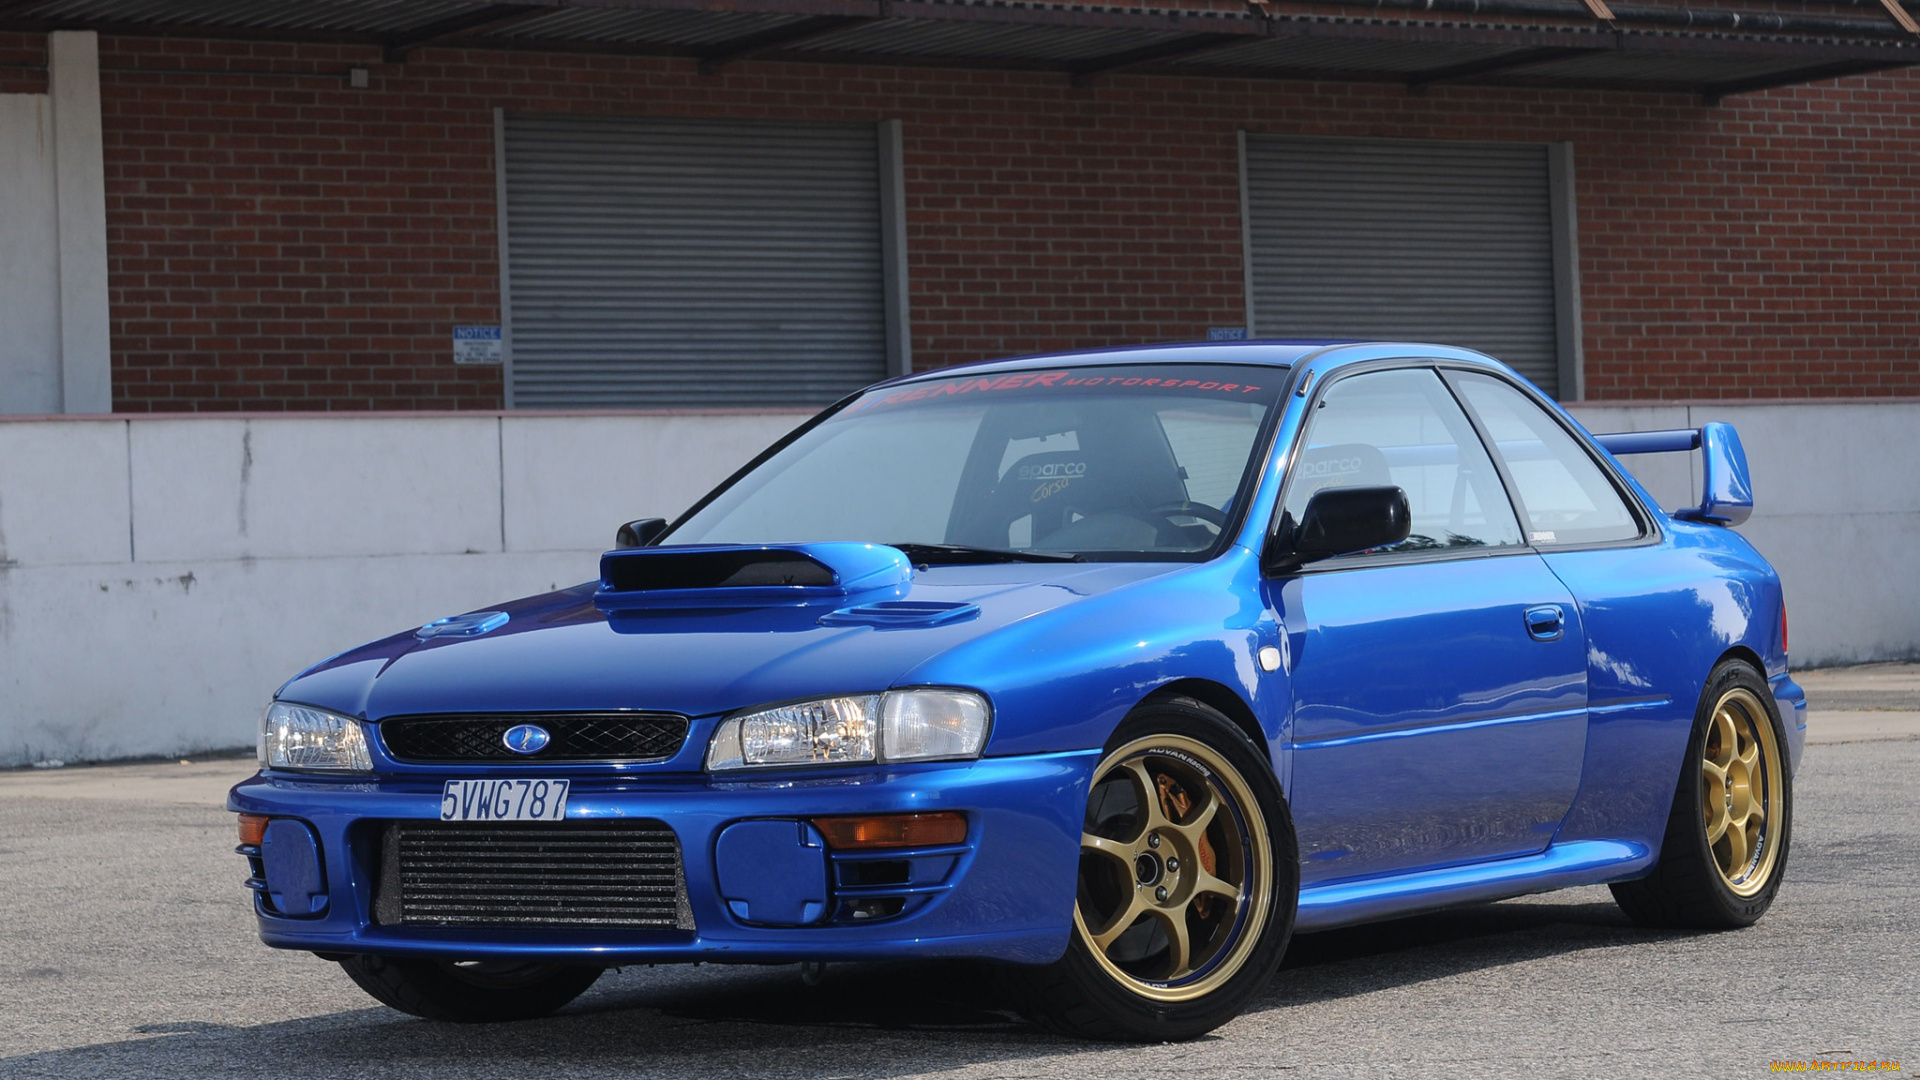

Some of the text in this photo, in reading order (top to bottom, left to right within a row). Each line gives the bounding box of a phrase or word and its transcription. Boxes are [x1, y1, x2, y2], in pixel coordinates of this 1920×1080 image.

[457, 328, 497, 339] NOTICE
[1062, 377, 1261, 393] MOTORSPORT
[1019, 462, 1086, 480] sparco
[1148, 748, 1187, 761] ADVAN
[443, 780, 569, 820] 5VWG787
